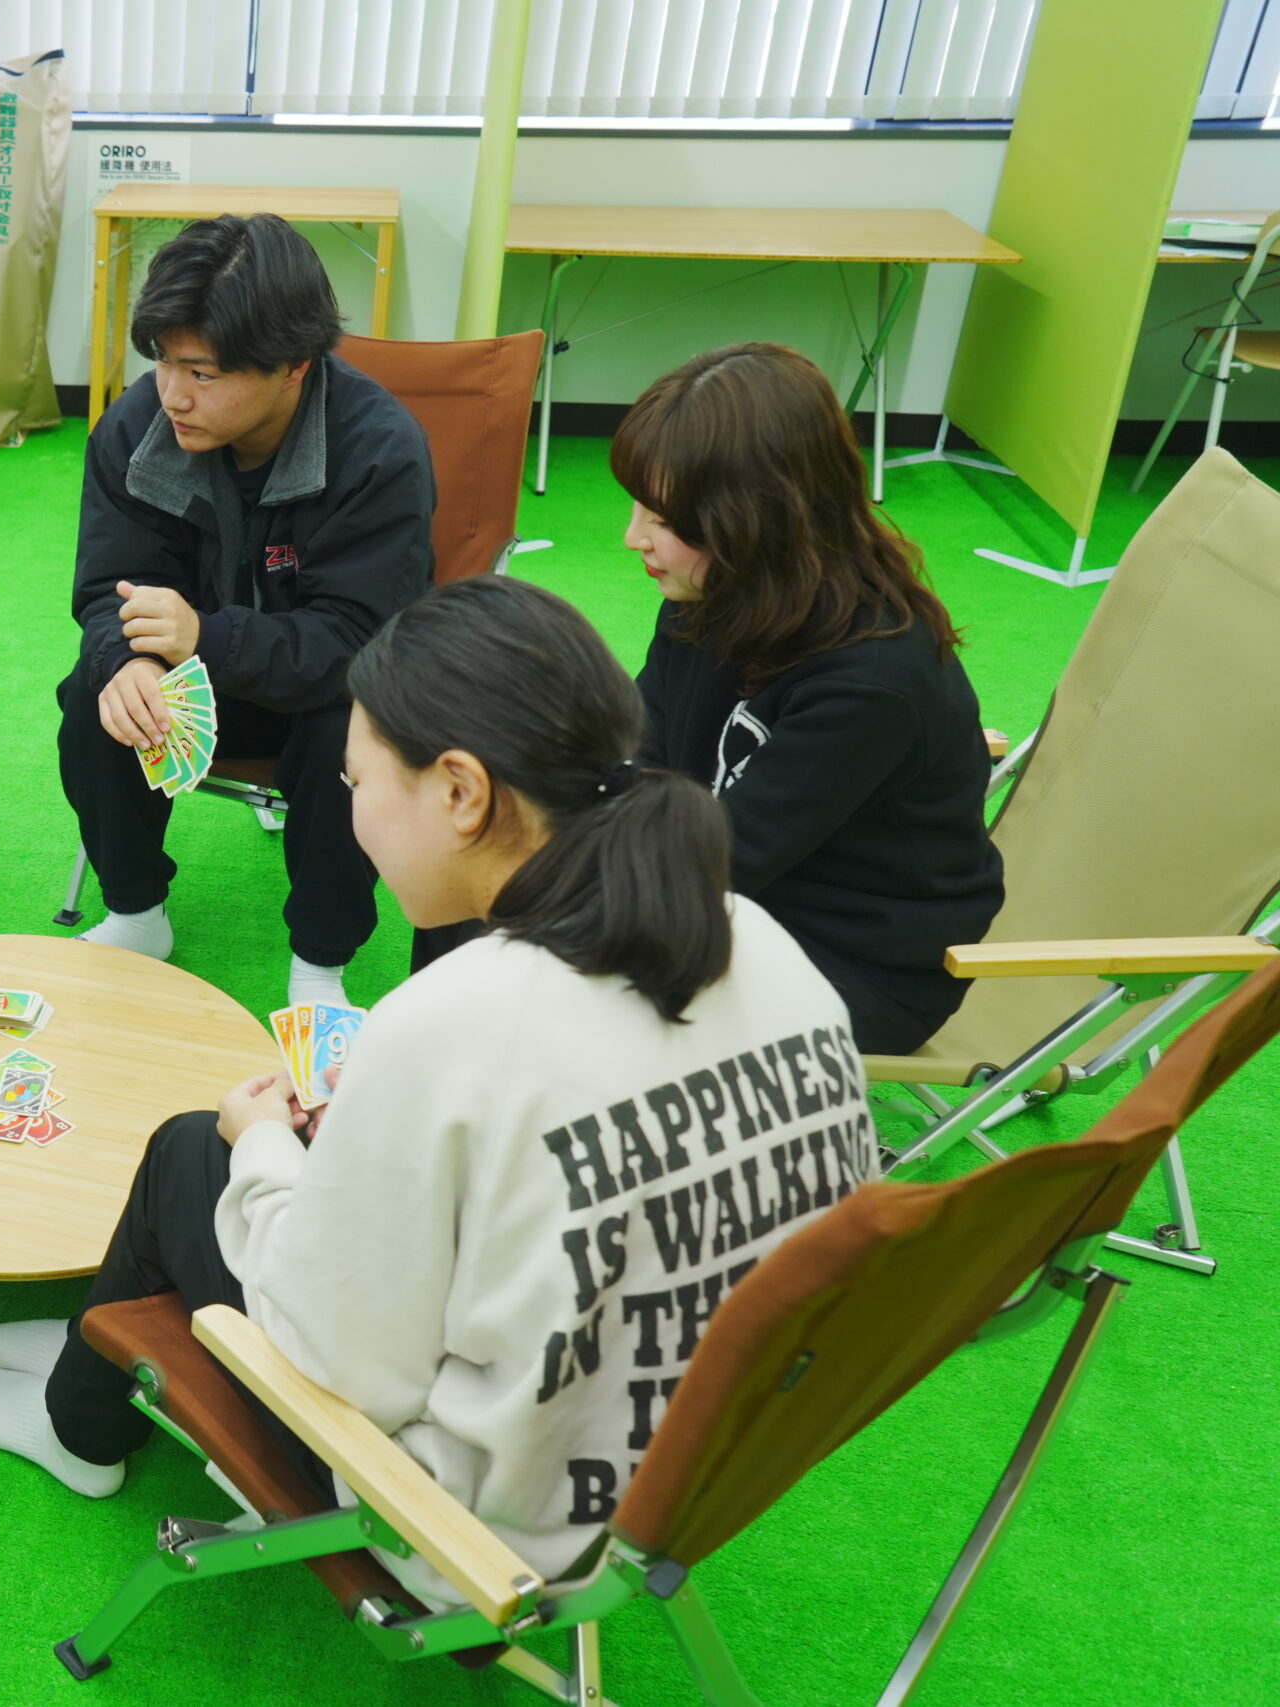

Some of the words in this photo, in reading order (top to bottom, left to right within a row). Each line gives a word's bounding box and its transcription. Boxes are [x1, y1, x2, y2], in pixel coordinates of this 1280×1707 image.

[100, 145, 146, 158] ORIRO
[278, 1016, 289, 1033] 7
[300, 1009, 310, 1026] 9
[317, 1008, 328, 1025] 9
[543, 1025, 861, 1211] HAPPINESS
[562, 1211, 629, 1314] IS
[643, 1113, 870, 1274] WALKING
[622, 1257, 759, 1368] TH
[627, 1377, 680, 1450] I
